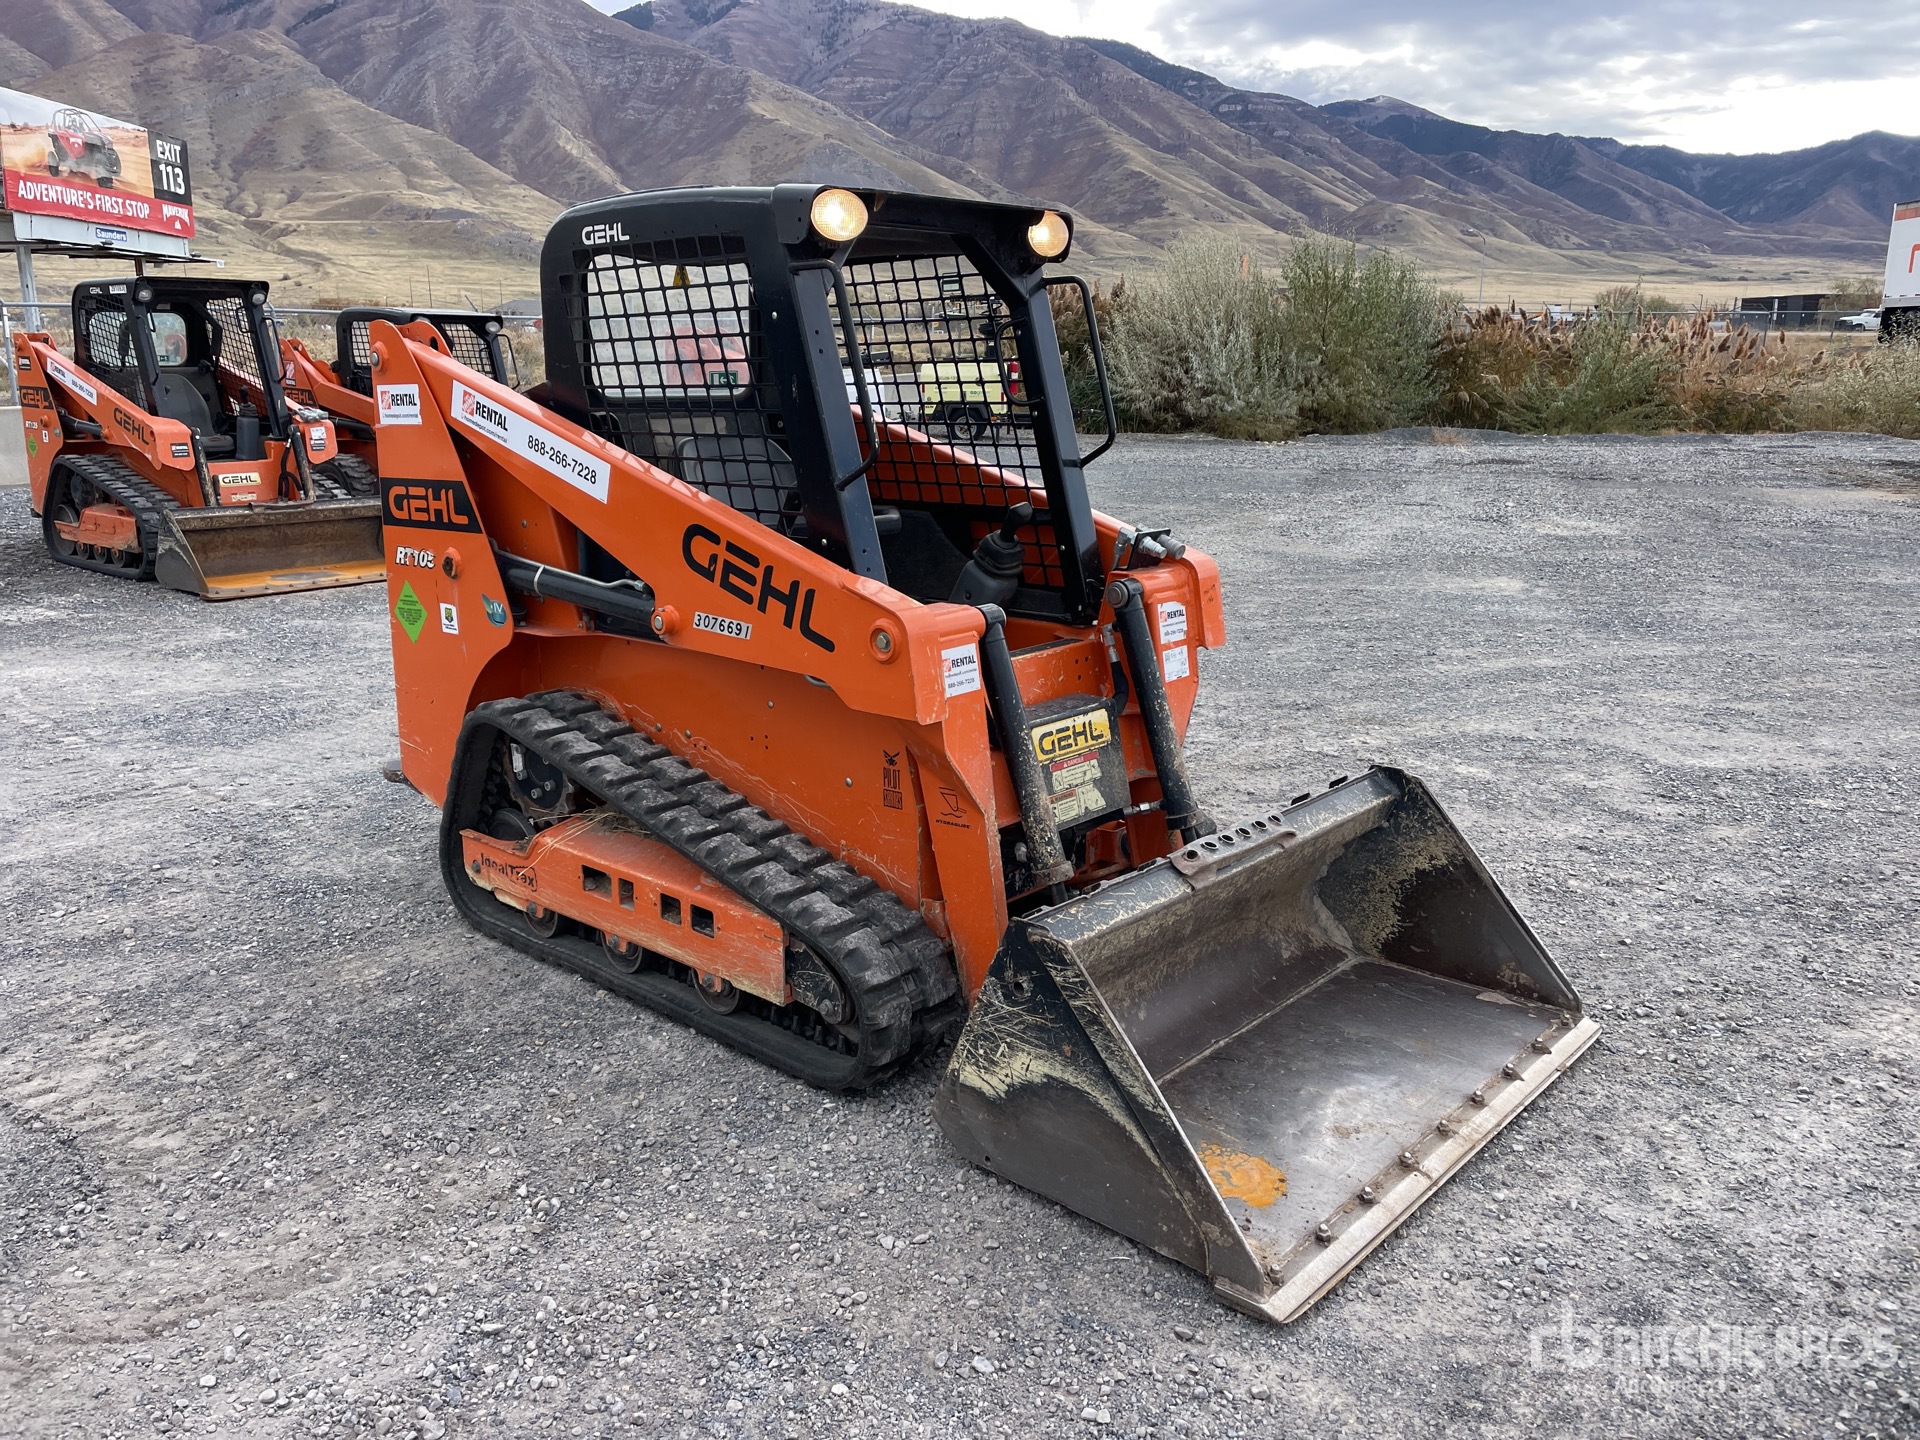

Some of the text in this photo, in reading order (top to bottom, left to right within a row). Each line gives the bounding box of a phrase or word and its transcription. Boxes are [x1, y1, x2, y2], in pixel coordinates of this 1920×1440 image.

[156, 139, 181, 164] EXIT
[159, 163, 185, 195] 113
[18, 179, 149, 219] ADVENTURE'S FIRST STOP
[96, 228, 127, 241] Saunders
[581, 222, 630, 245] GEHL
[20, 388, 49, 407] GEHL
[390, 393, 417, 407] RENTAL
[113, 407, 150, 446] GEHL
[475, 400, 508, 432] RENTAL
[527, 434, 598, 485] 888-266-7228
[221, 474, 258, 485] GEHL
[388, 485, 469, 525] GEHL
[395, 545, 436, 569] RT105
[681, 523, 836, 653] GEHL
[1167, 608, 1185, 620] RENTAL
[951, 655, 976, 669] RENTAL
[1038, 719, 1105, 756] GEHL
[883, 767, 900, 790] PILOT
